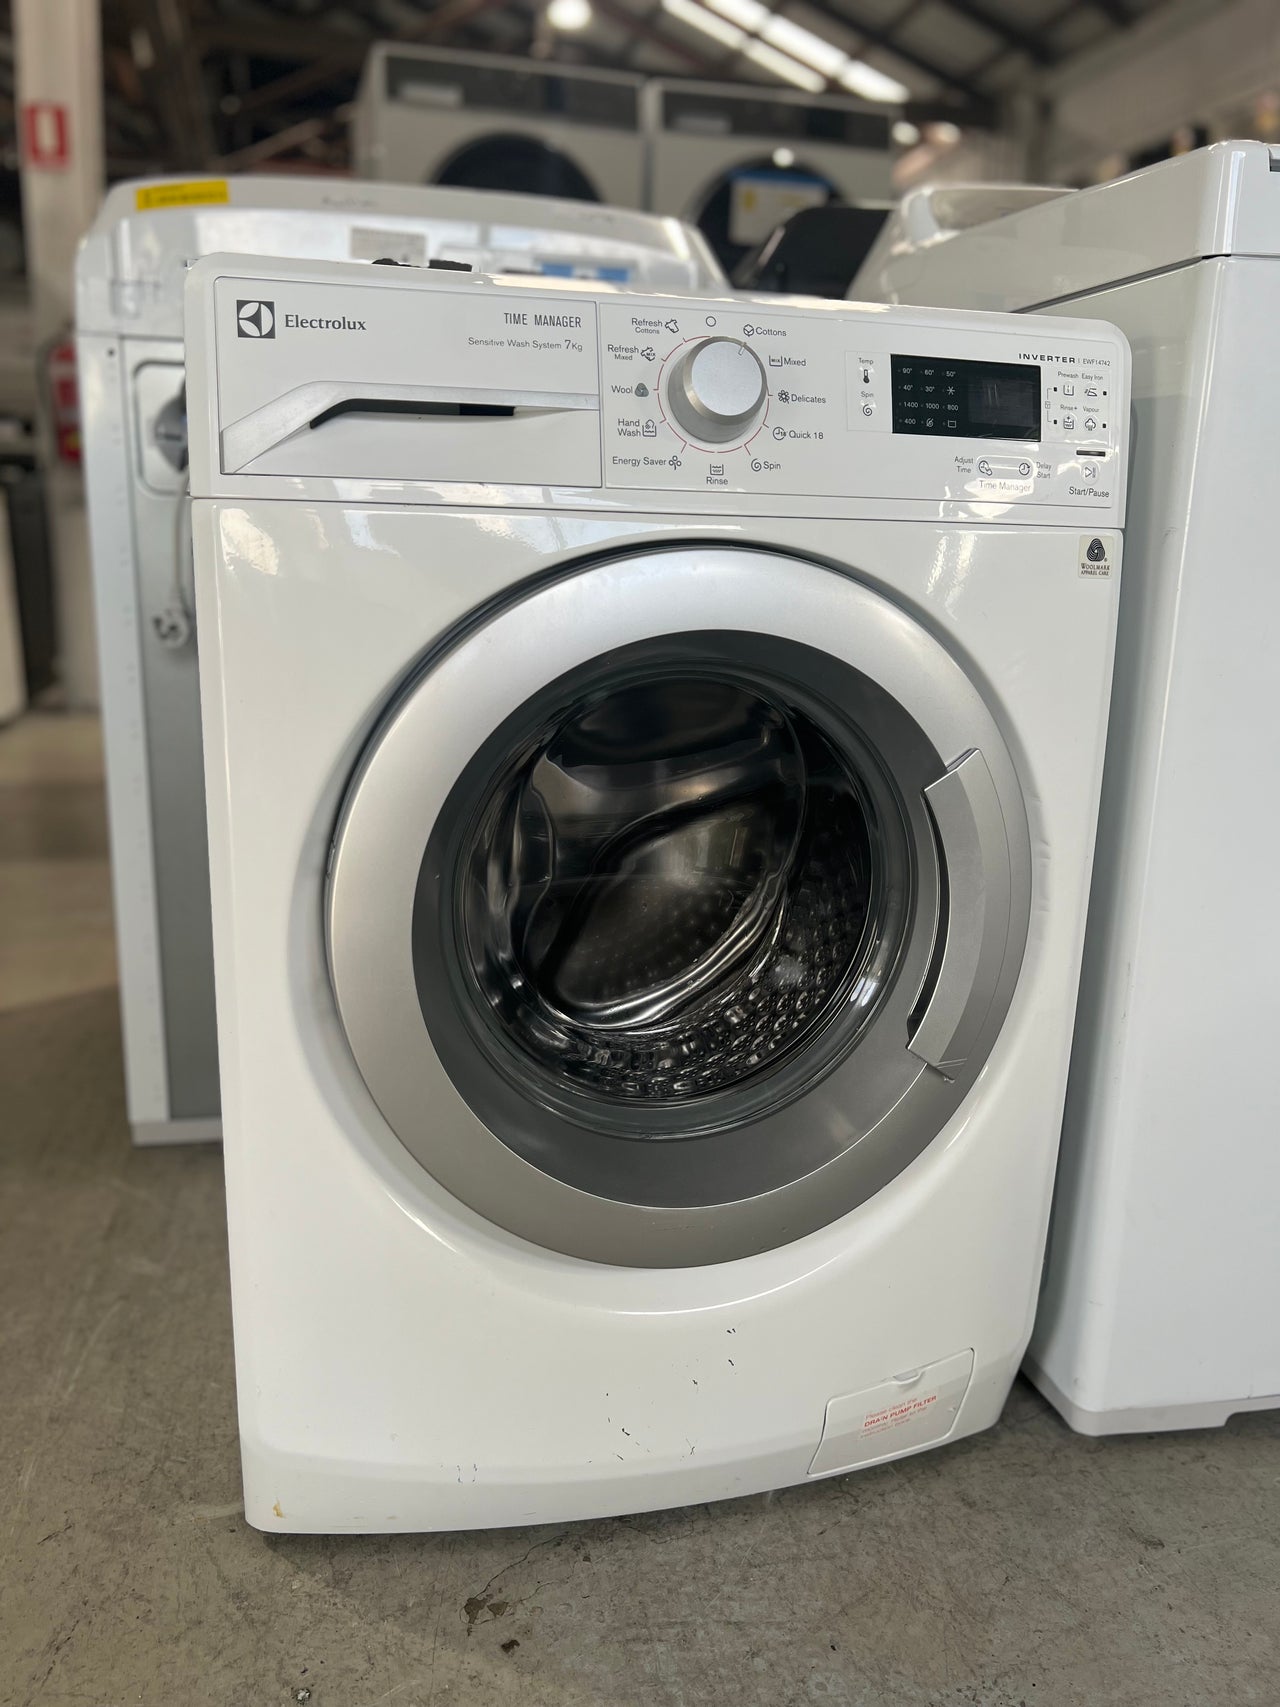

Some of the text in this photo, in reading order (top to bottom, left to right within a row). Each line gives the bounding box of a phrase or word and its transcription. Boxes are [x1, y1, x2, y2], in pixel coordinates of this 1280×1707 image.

[285, 314, 367, 331] Electrolux
[503, 312, 582, 328] TIME MANAGER
[631, 317, 663, 327] Refresh
[635, 326, 660, 334] Cottons
[755, 326, 787, 337] Cottons
[468, 337, 583, 352] Sensitive Wash System 7Kg
[607, 344, 639, 354] Refresh
[614, 353, 633, 361] Mixed
[859, 357, 874, 366] Temp
[1018, 353, 1076, 364] INVERTER
[783, 357, 807, 367] Mixed
[1082, 358, 1111, 367] EWF14742
[1057, 371, 1079, 379] Prewash
[1081, 373, 1093, 381] Easy
[611, 385, 633, 394] Wool
[791, 393, 826, 404] Delicates
[860, 391, 874, 399] Spin
[1083, 405, 1100, 413] Vapour
[617, 418, 640, 427] Hand
[617, 428, 641, 437] Wash
[789, 430, 824, 440] Quick 18
[612, 456, 666, 467] Energy Saver
[954, 456, 974, 465] Adjust
[763, 461, 782, 471] Spin
[957, 466, 972, 474] Time
[1036, 462, 1052, 470] Delay
[1037, 471, 1051, 479] Start
[706, 476, 729, 485] Rinse
[979, 480, 1032, 493] Time Manager
[1068, 486, 1110, 498] Start/Pause
[889, 1406, 912, 1418] PUMP
[913, 1395, 937, 1409] FILTER
